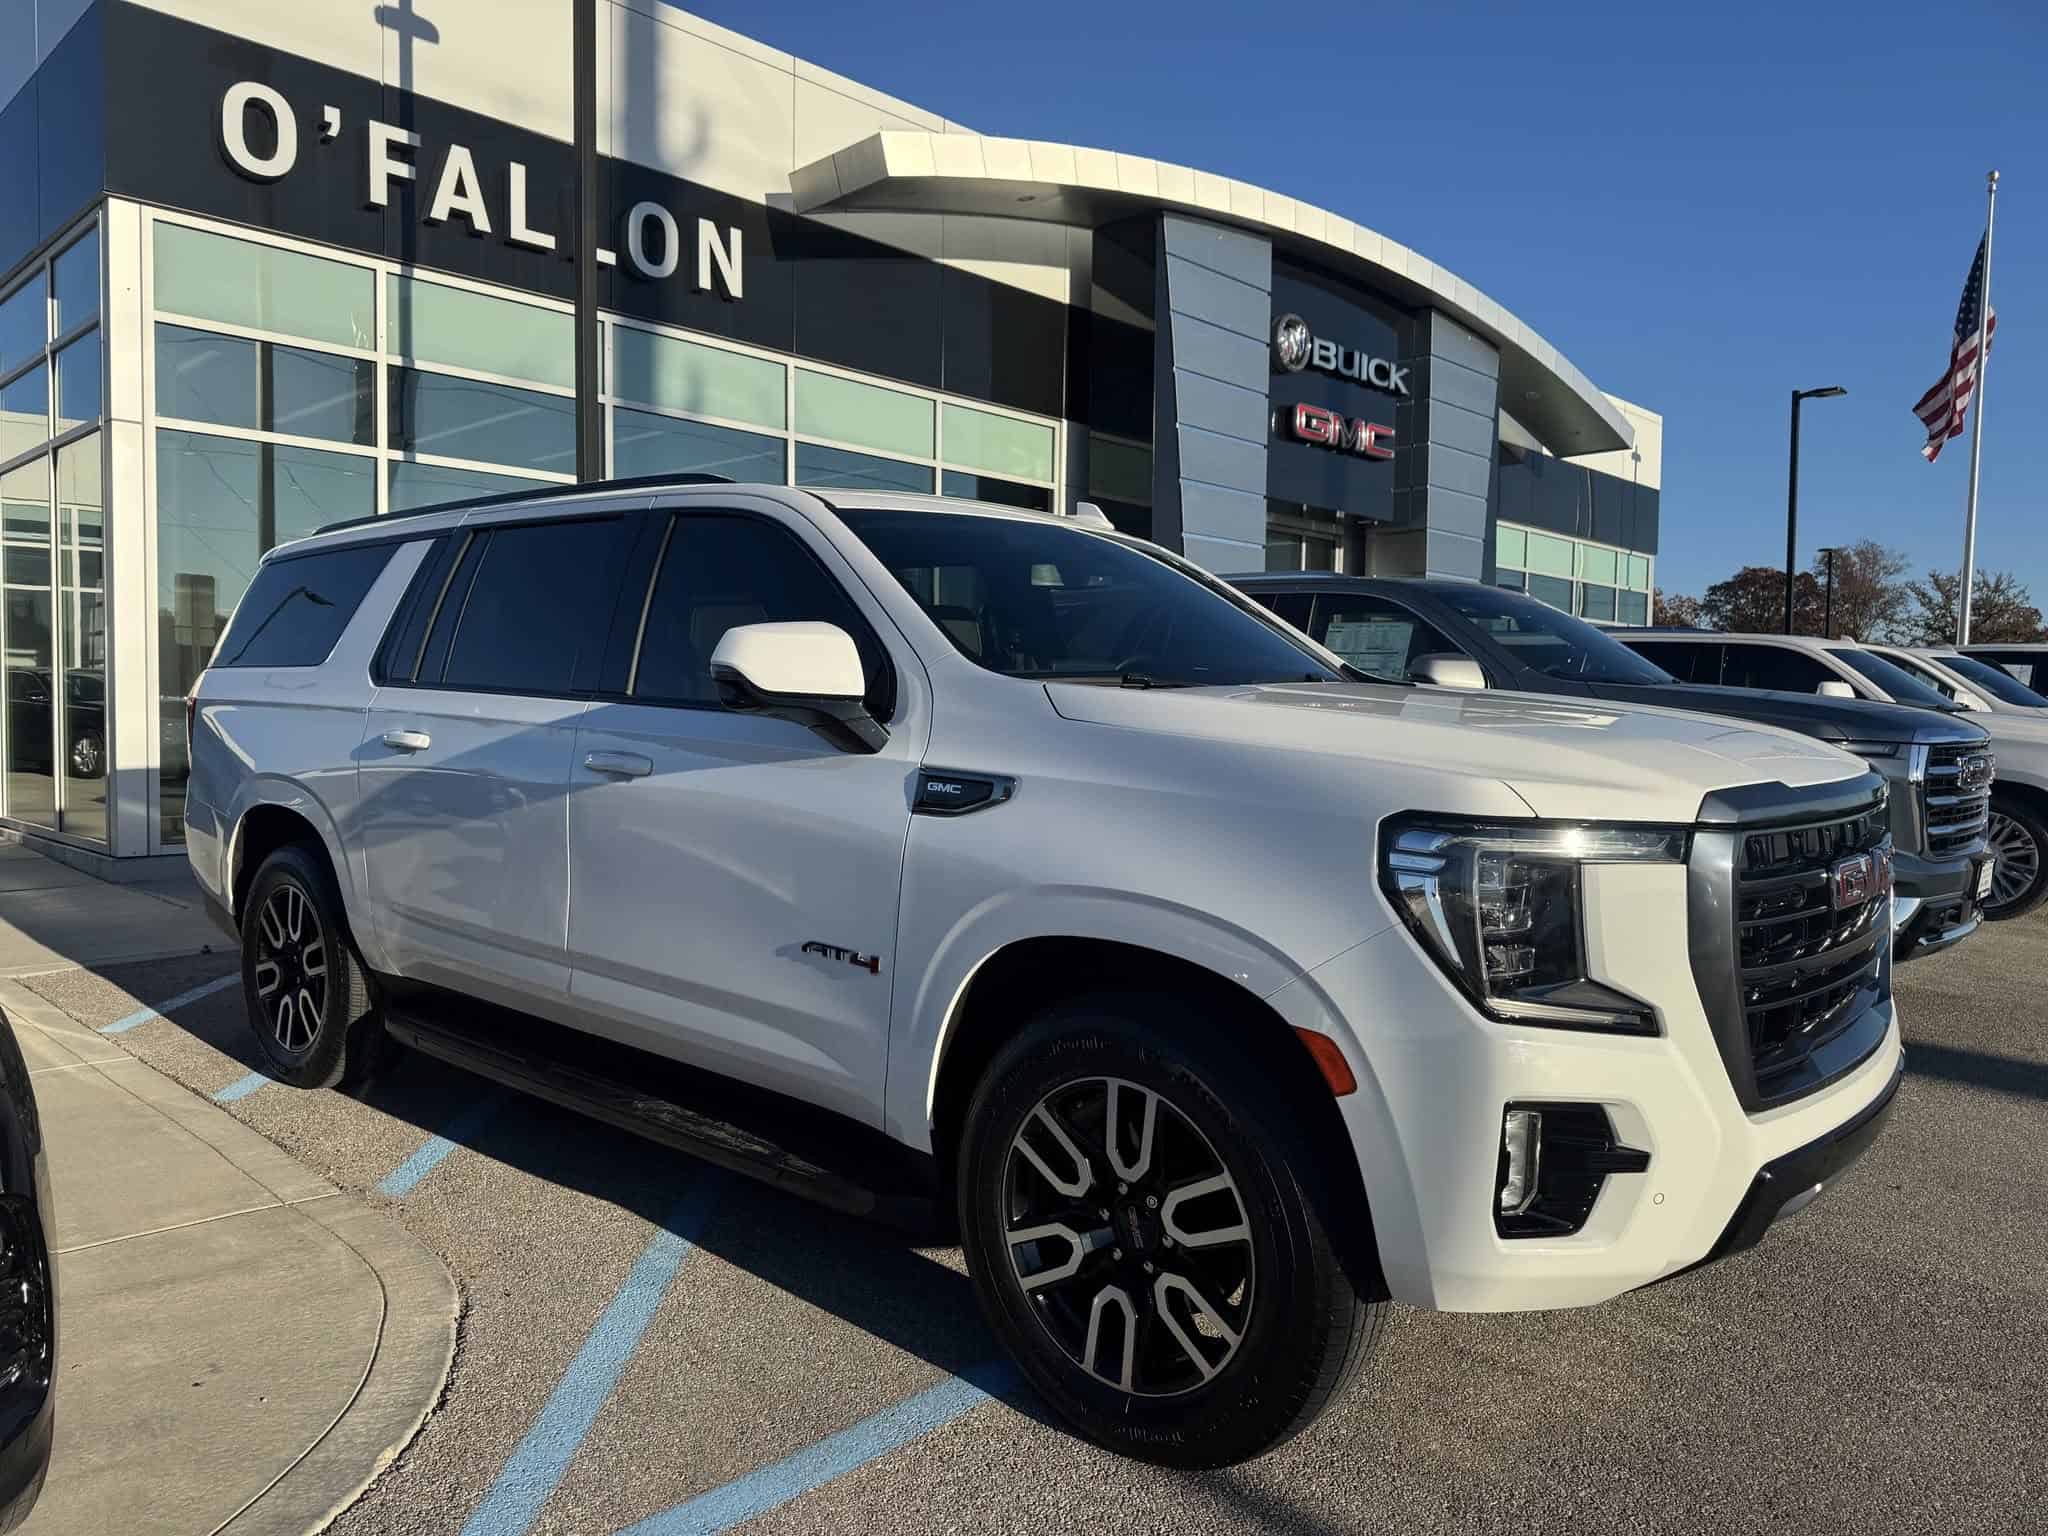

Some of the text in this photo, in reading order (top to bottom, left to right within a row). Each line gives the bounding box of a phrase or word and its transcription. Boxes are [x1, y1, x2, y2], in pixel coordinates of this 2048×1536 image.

[1312, 335, 1410, 395] BUICK
[1295, 402, 1396, 460] GMC
[927, 781, 962, 794] GMC
[801, 940, 880, 975] AT4
